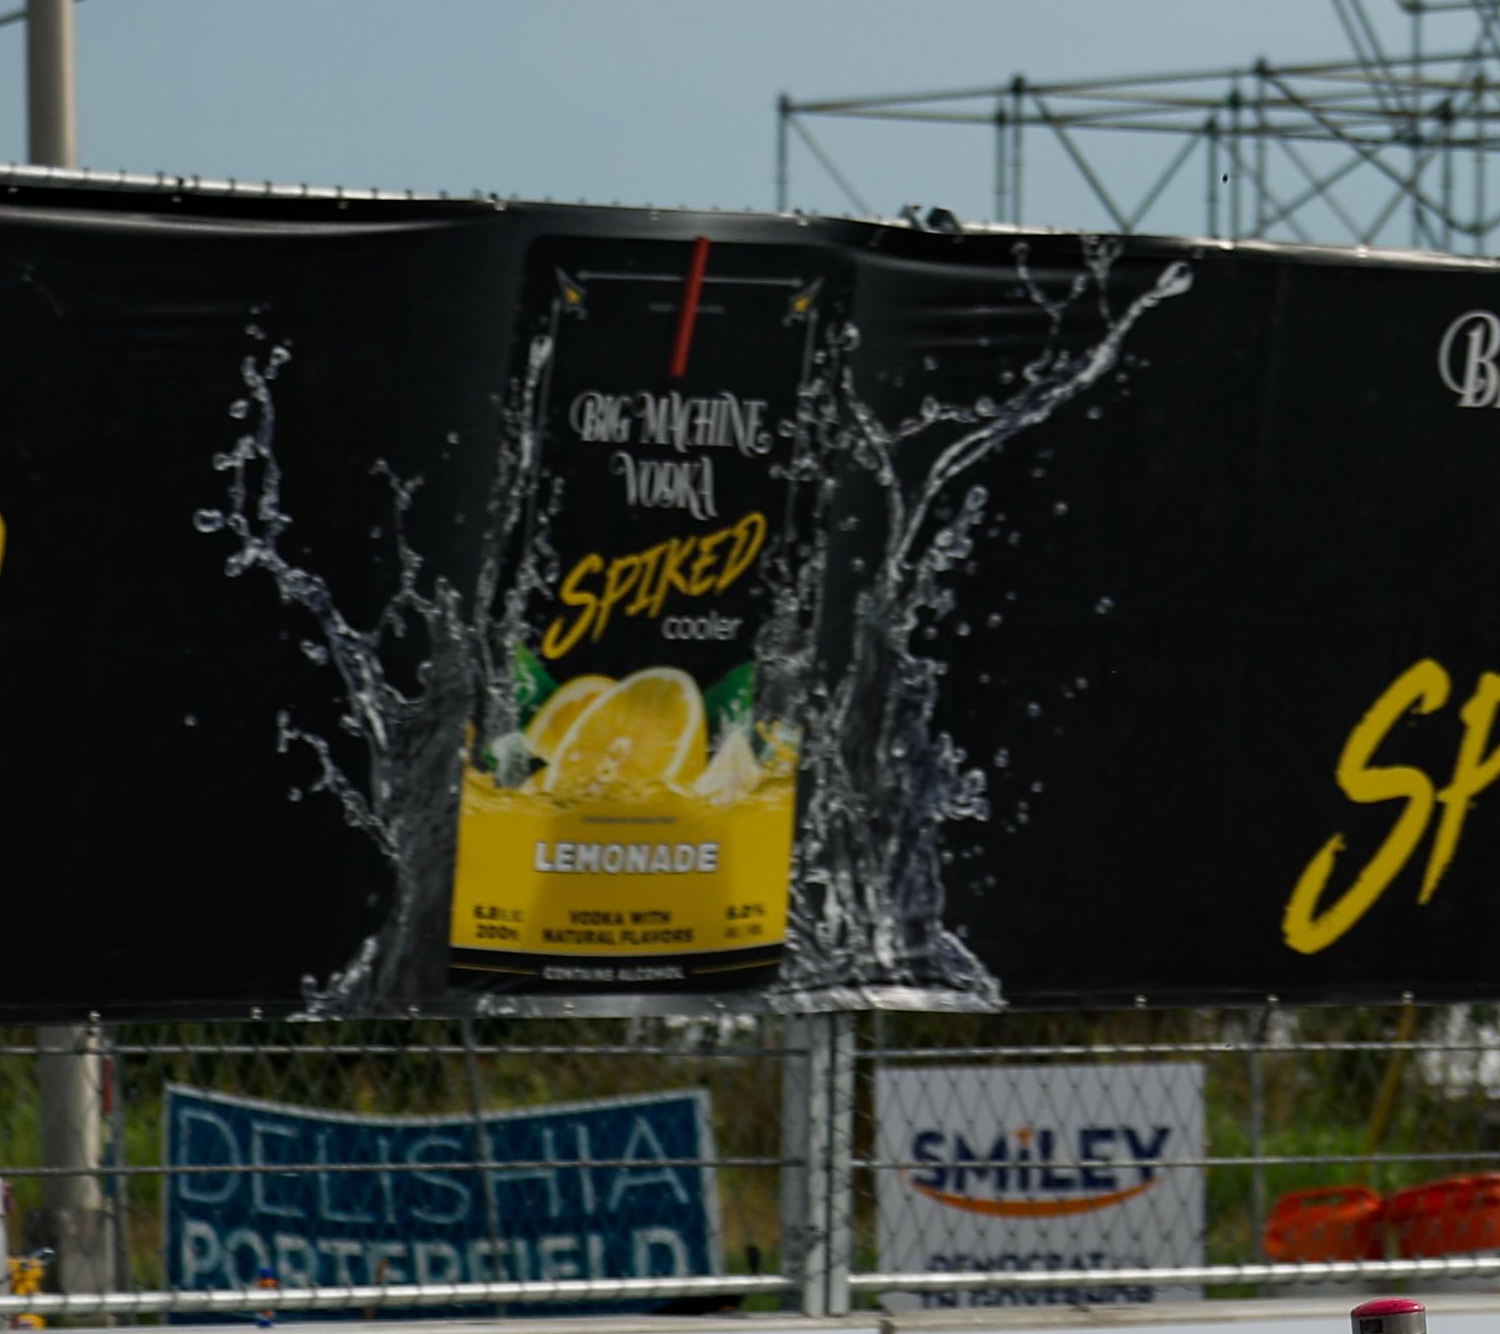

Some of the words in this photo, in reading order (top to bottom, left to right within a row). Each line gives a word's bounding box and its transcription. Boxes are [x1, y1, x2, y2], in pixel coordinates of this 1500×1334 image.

[569, 391, 632, 443] BIG
[634, 391, 773, 458] MACHINE
[542, 512, 767, 659] SPIKED
[662, 610, 743, 640] cooler
[535, 841, 720, 874] LEMONADE
[569, 909, 625, 925] VODKA
[631, 909, 673, 925] WITH
[543, 928, 615, 945] NATURAL
[176, 1108, 691, 1225] DELISHIA
